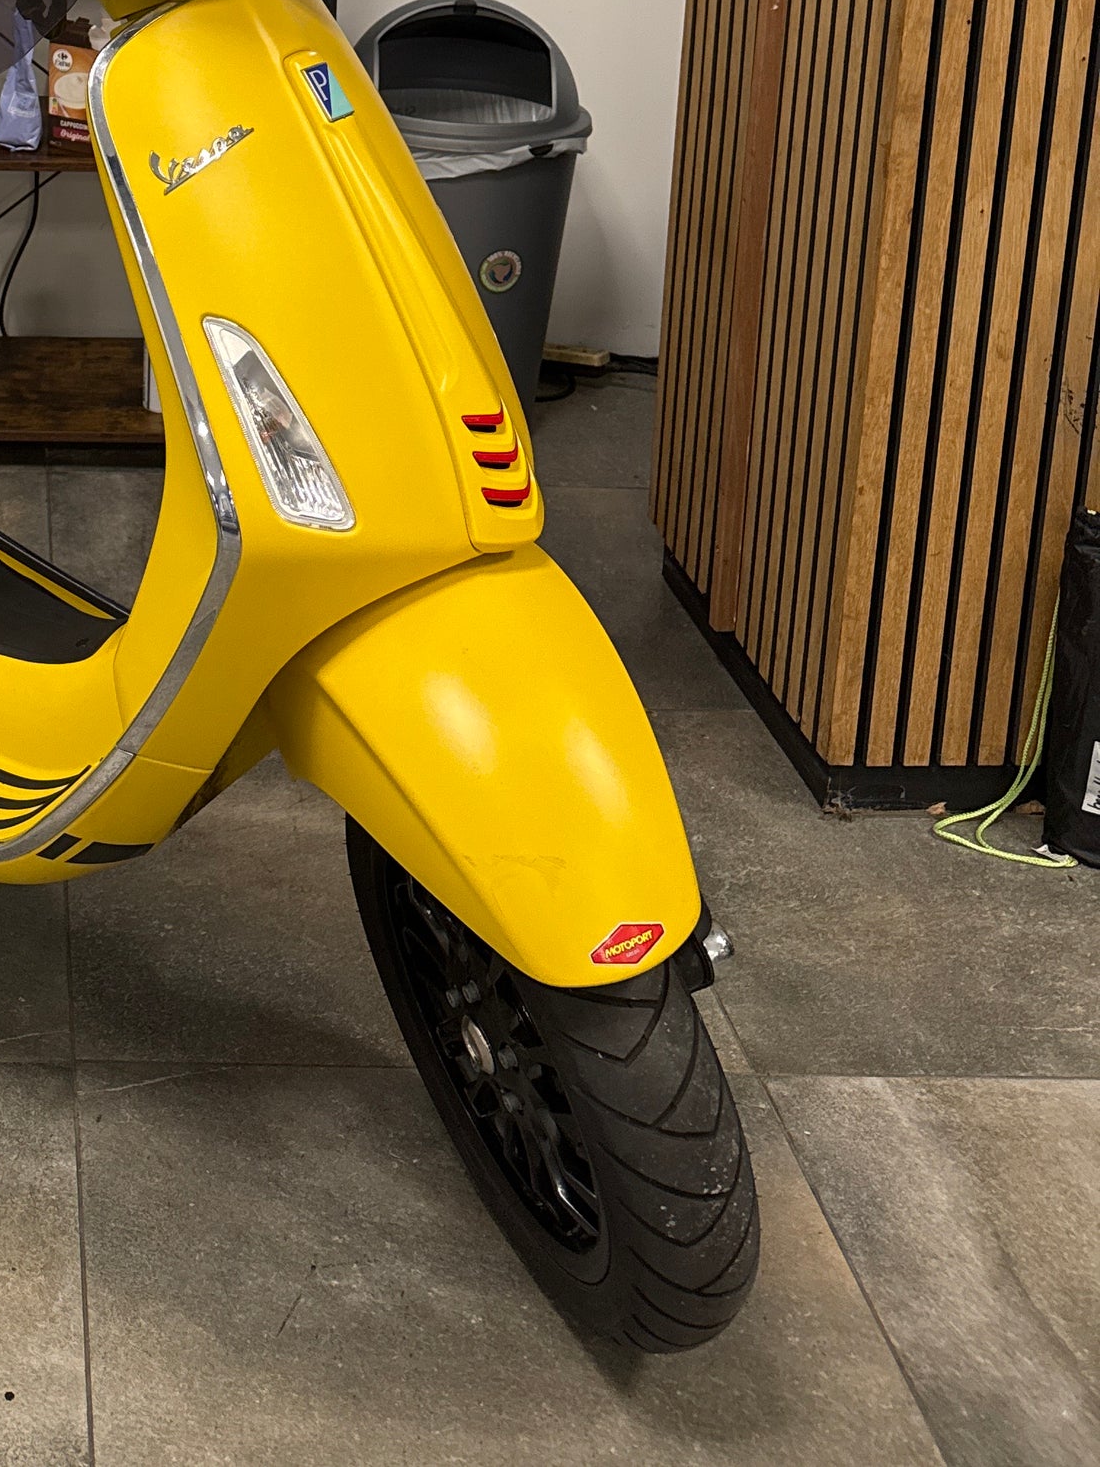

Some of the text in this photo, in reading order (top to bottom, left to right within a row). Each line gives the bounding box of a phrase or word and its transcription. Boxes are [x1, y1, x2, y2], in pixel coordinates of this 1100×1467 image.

[309, 69, 328, 101] P
[149, 124, 255, 196] Vespa
[605, 930, 653, 959] MOTOPORT
